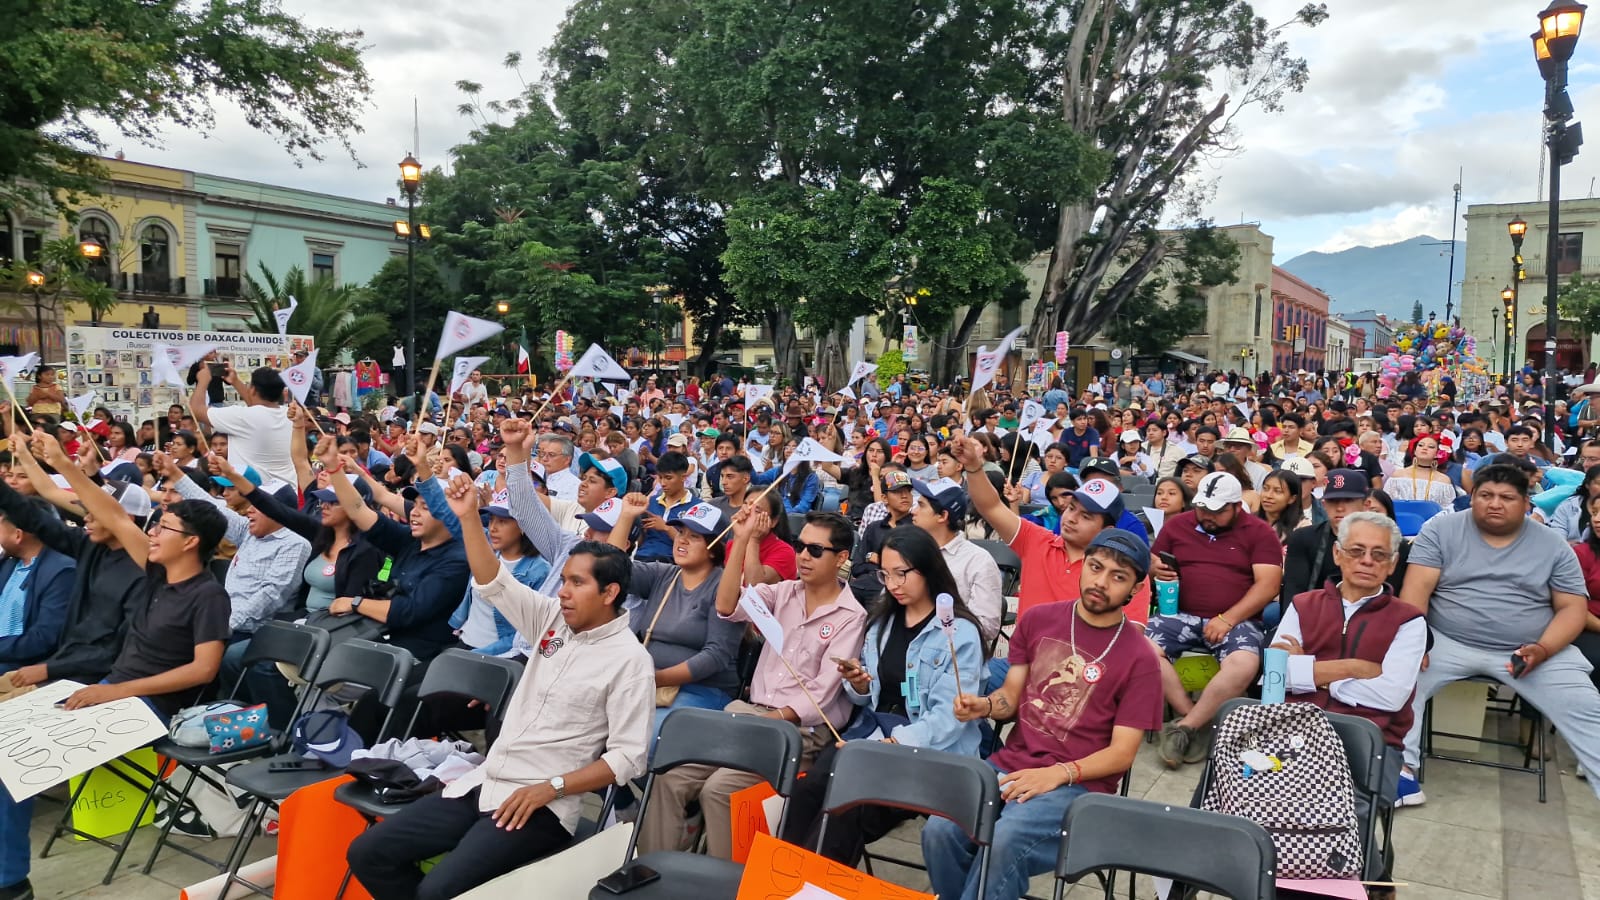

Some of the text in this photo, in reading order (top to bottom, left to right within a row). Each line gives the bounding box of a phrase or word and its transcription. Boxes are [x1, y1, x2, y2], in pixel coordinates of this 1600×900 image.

[112, 330, 285, 345] COLECTIVOS DE OAXACA UNIDOS
[1333, 474, 1345, 489] B
